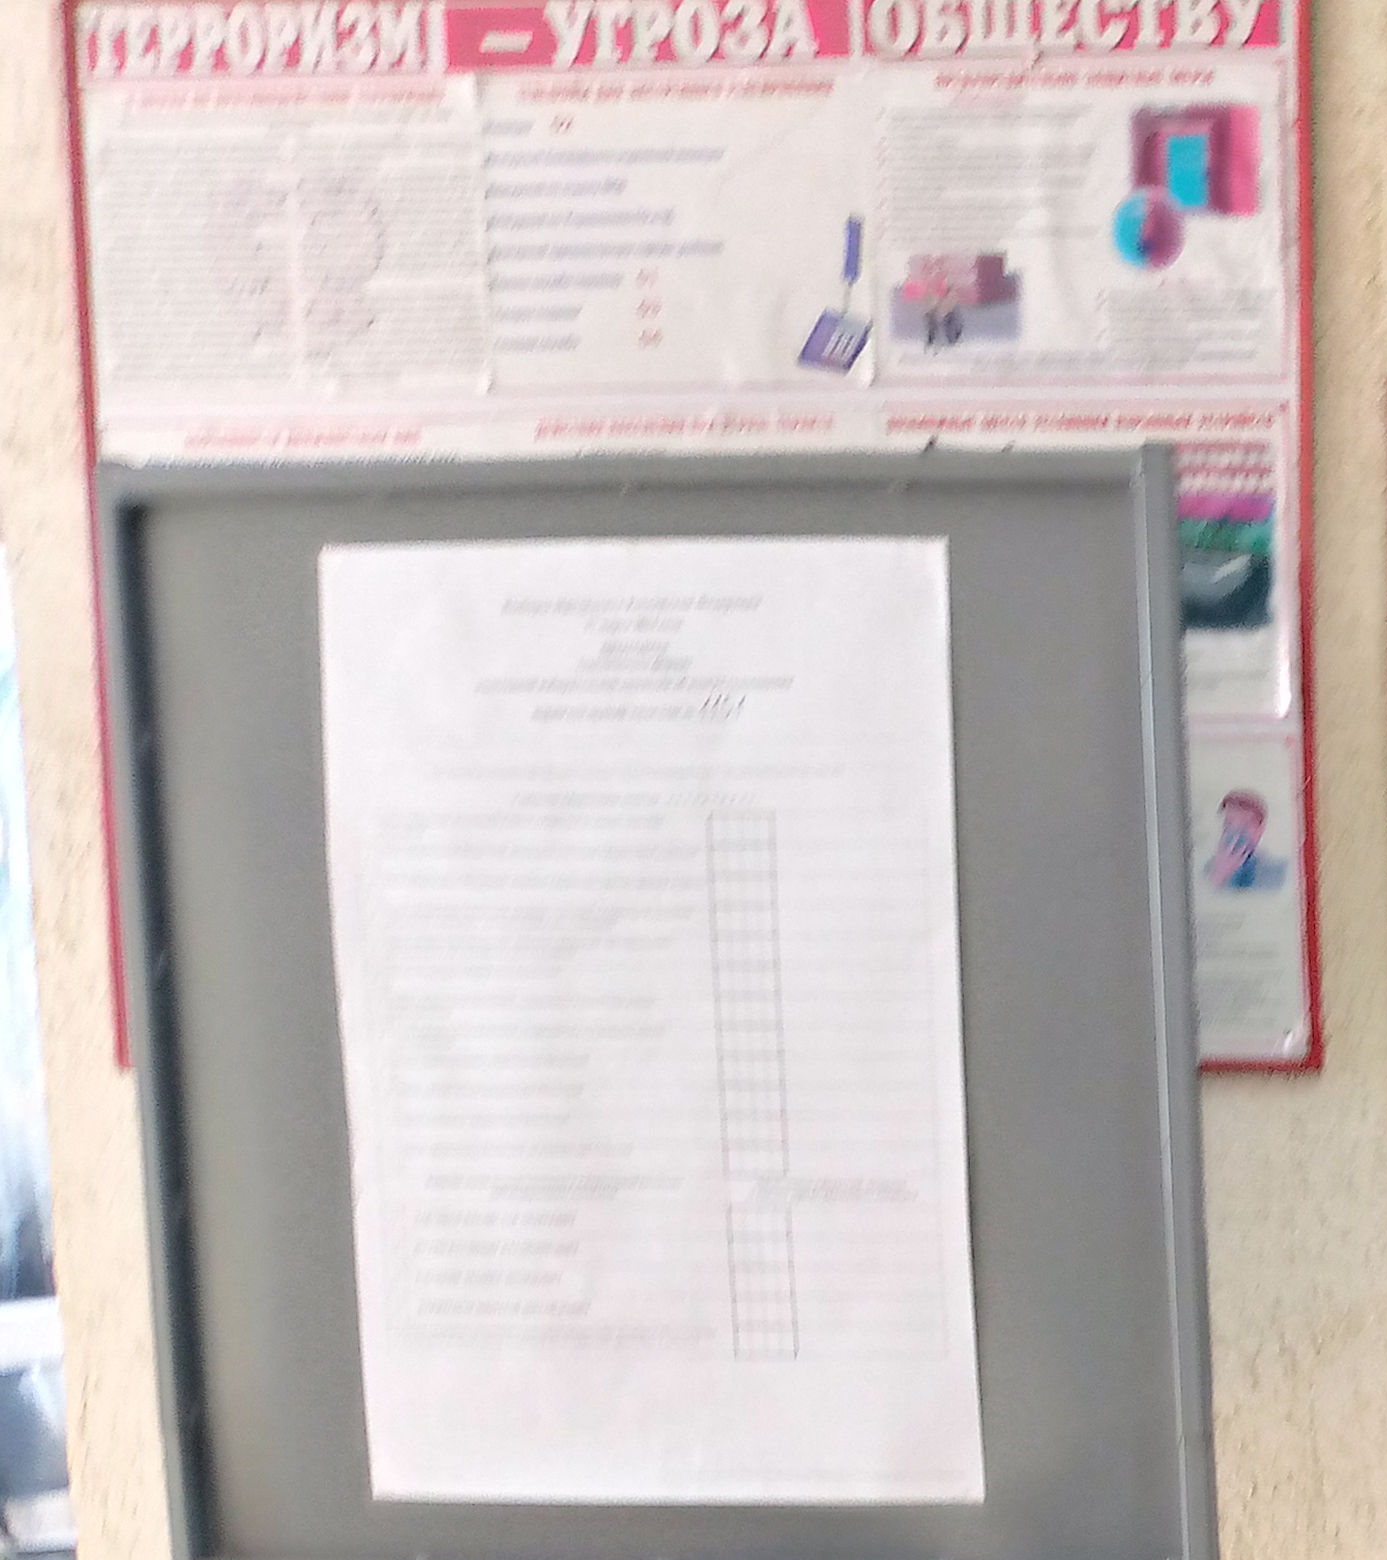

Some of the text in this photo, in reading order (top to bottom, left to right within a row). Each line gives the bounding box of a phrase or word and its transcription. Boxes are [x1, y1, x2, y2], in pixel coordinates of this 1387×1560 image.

[80, 2, 430, 74] ТЕРРОРИЗМ
[543, 0, 819, 70] УГРОЗА
[869, 0, 1270, 57] ОБЩЕСТВУ
